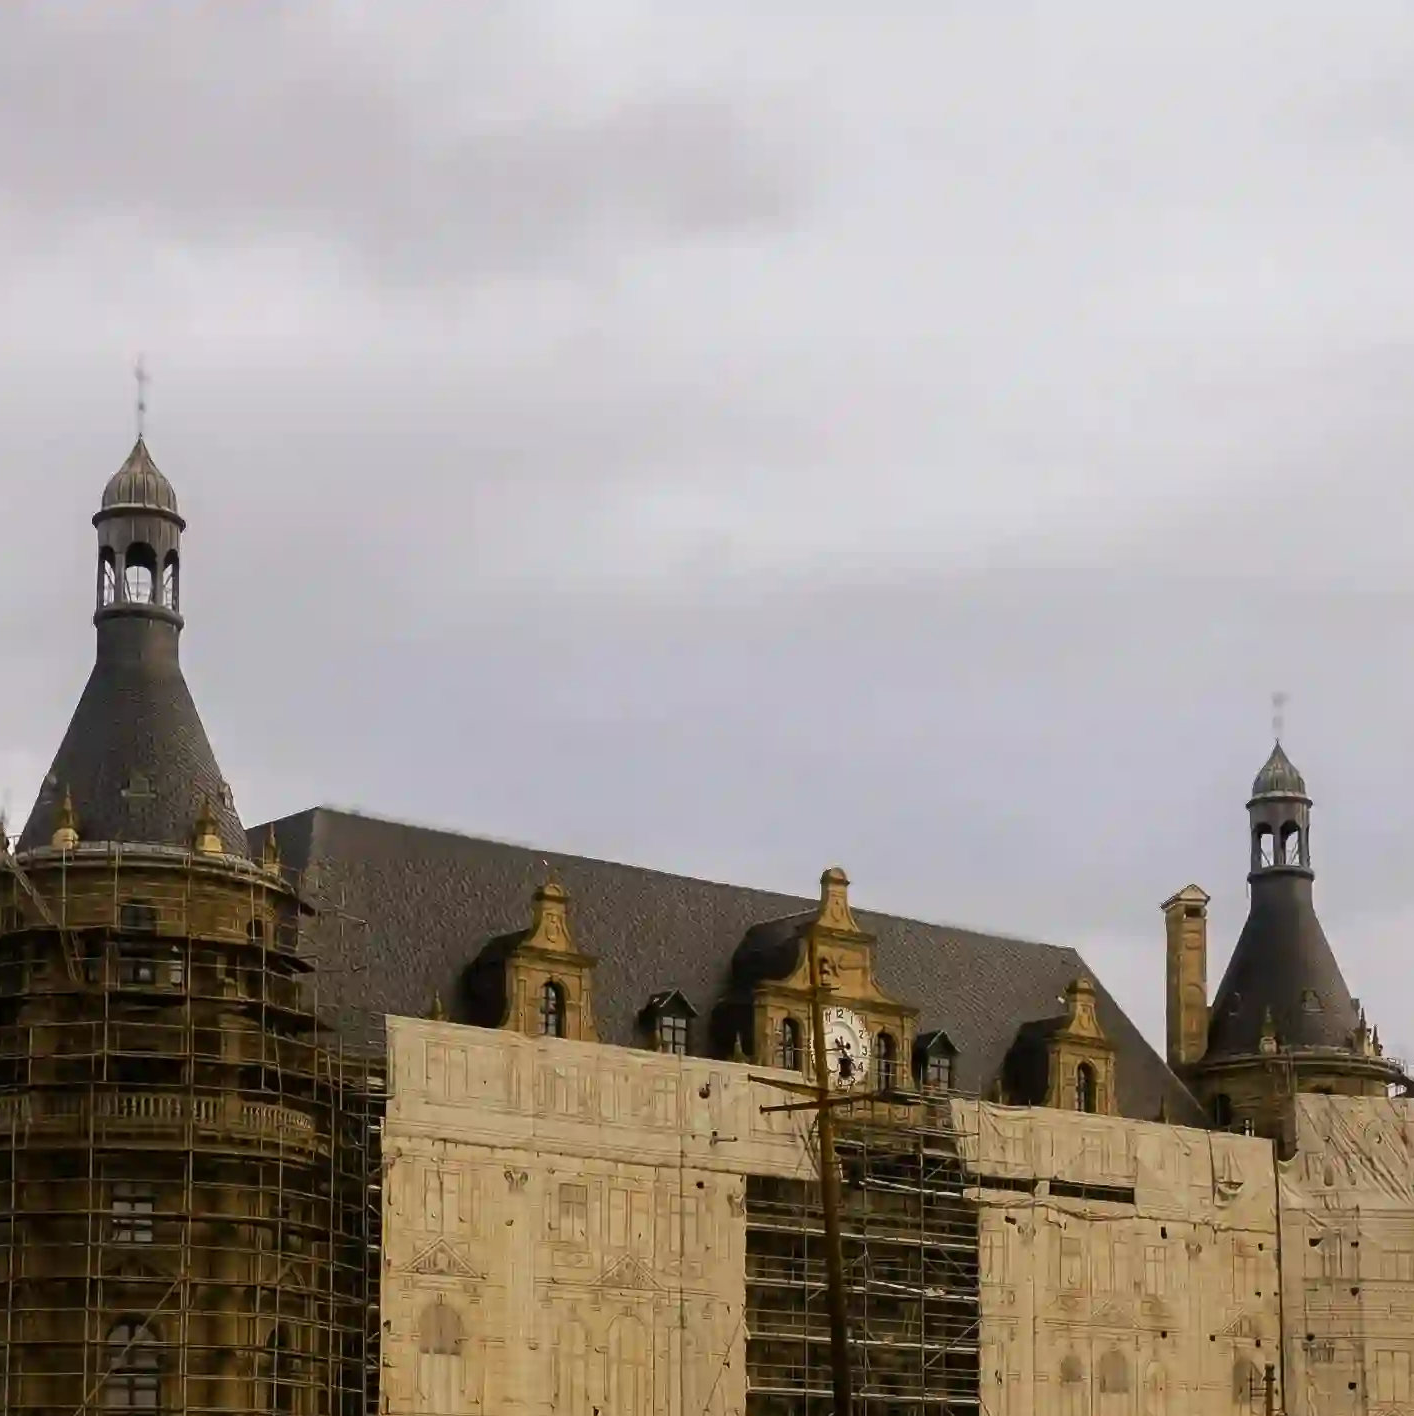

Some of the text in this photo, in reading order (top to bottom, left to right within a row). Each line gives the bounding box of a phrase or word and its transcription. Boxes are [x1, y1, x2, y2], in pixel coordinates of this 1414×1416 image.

[836, 1008, 844, 1019] 12
[858, 1029, 864, 1040] 2
[857, 1061, 864, 1073] 4
